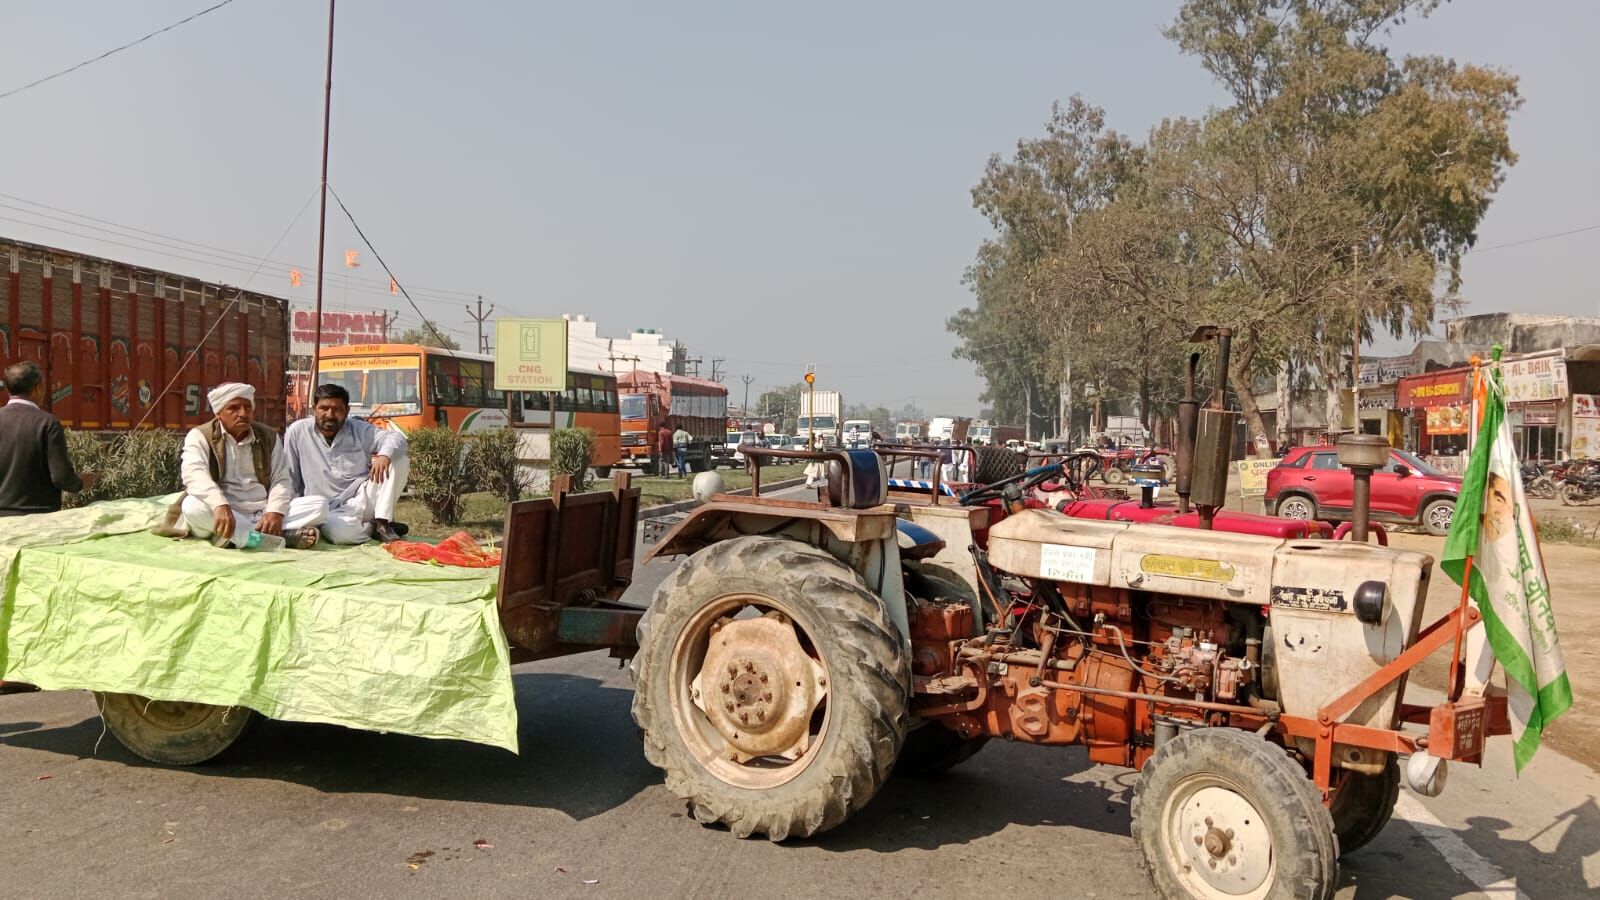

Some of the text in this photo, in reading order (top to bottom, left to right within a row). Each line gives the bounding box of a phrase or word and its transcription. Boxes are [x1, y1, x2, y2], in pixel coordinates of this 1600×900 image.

[519, 364, 542, 374] CNG
[1528, 360, 1552, 375] BAIK
[507, 375, 553, 385] STATION
